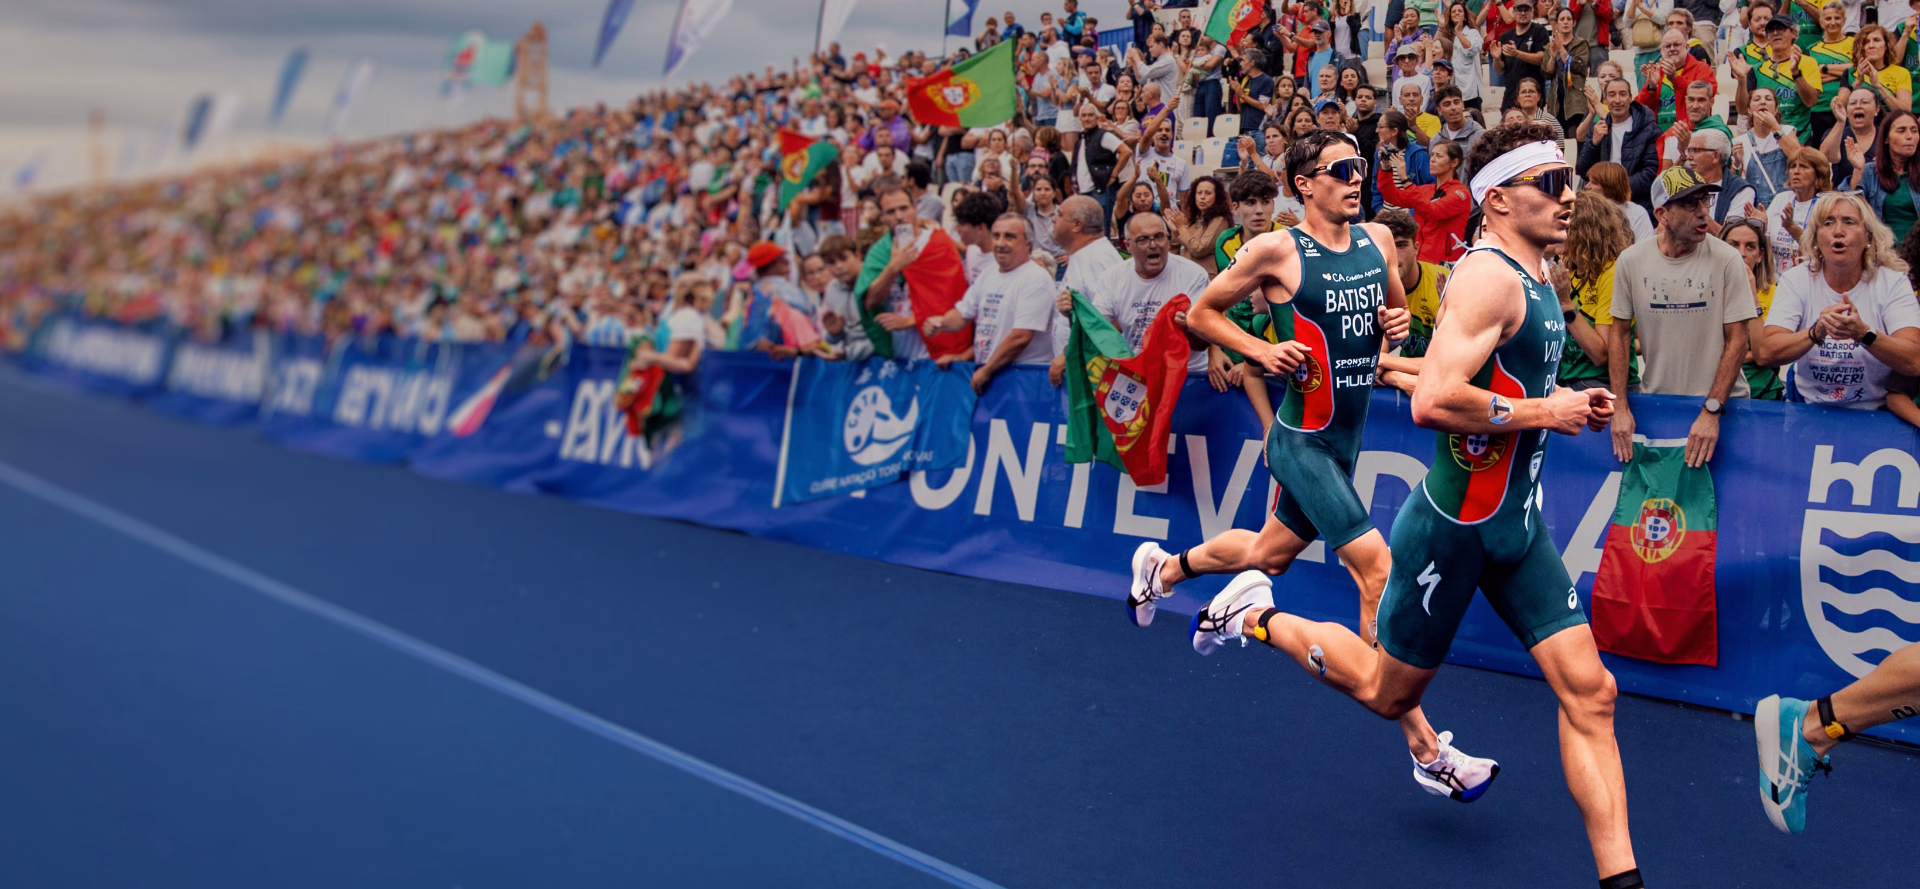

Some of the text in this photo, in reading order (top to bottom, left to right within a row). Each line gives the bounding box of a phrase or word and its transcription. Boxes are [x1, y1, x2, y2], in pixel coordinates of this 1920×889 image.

[1332, 272, 1346, 282] CA
[1325, 282, 1384, 313] BATISTA
[1341, 312, 1374, 339] POR
[1819, 350, 1854, 359] BATISTA
[1335, 357, 1371, 369] SPONSER
[1336, 373, 1374, 389] HUUB
[1812, 371, 1865, 384] VENCER!
